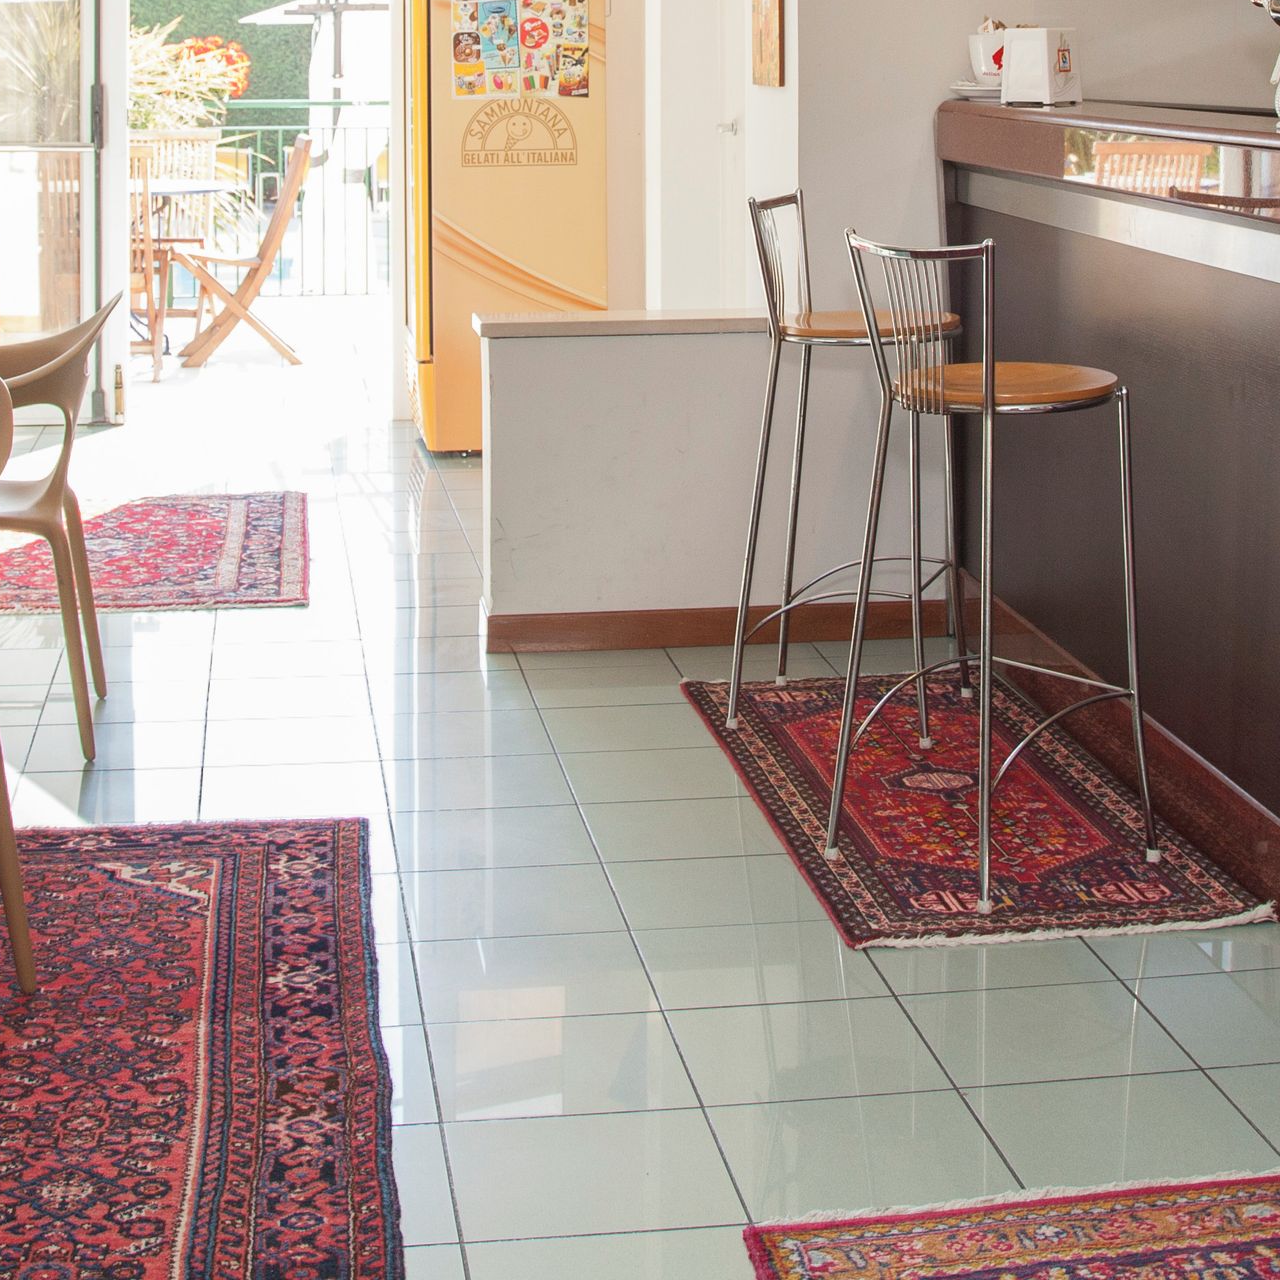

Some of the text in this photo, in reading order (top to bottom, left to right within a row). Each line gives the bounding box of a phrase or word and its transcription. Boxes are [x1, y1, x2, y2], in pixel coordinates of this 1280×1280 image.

[469, 99, 568, 140] SAMMONTANA
[464, 151, 575, 164] GELATI ALL'ITALIANA
